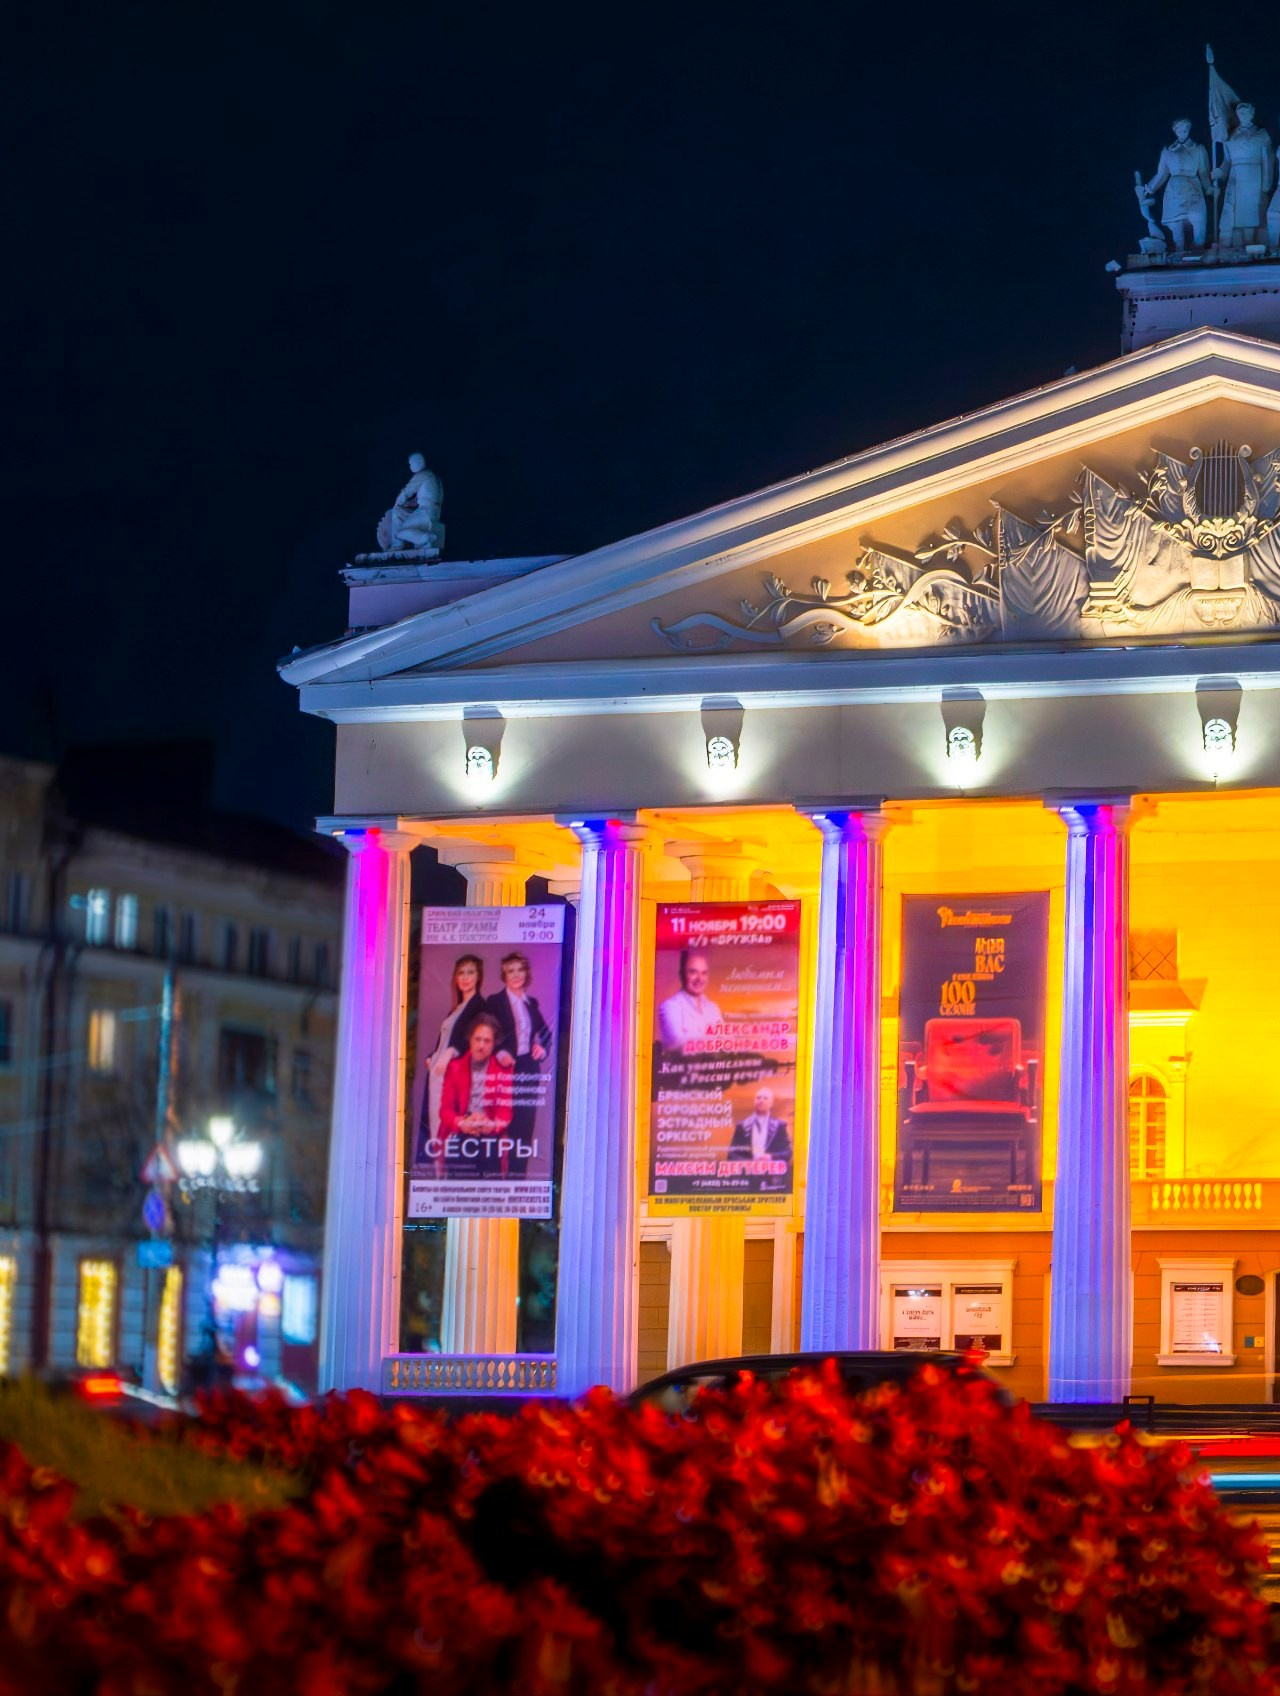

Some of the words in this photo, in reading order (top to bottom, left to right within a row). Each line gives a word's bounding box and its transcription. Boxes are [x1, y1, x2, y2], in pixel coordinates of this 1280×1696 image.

[528, 908, 546, 919] 24
[427, 922, 455, 933] ТЕАТР
[459, 921, 499, 932] ДРАМЫ
[671, 917, 686, 932] 11
[689, 920, 738, 932] НОЯБРЯ
[740, 914, 787, 931] 19:00
[522, 930, 555, 941] 19:00
[975, 954, 1005, 973] ВАС
[941, 980, 976, 1004] 100
[940, 1003, 976, 1016] СЕЗОНЕ
[705, 1022, 790, 1036] АЛЕКСАНДР
[684, 1038, 789, 1053] ДОБРОНРАВОВ
[690, 1072, 731, 1083] России
[657, 1087, 723, 1101] БРЯНСКИЙ
[657, 1101, 732, 1115] ГОРОДСКОЙ
[657, 1114, 733, 1129] ЭСТРАДНЫЙ
[656, 1131, 712, 1142] ОРКЕСТР
[424, 1133, 539, 1158] СЁСТРЫ
[655, 1161, 717, 1176] МАКСИМ
[717, 1160, 788, 1177] ДЕГТЕРЕВ
[415, 1203, 433, 1213] 16+
